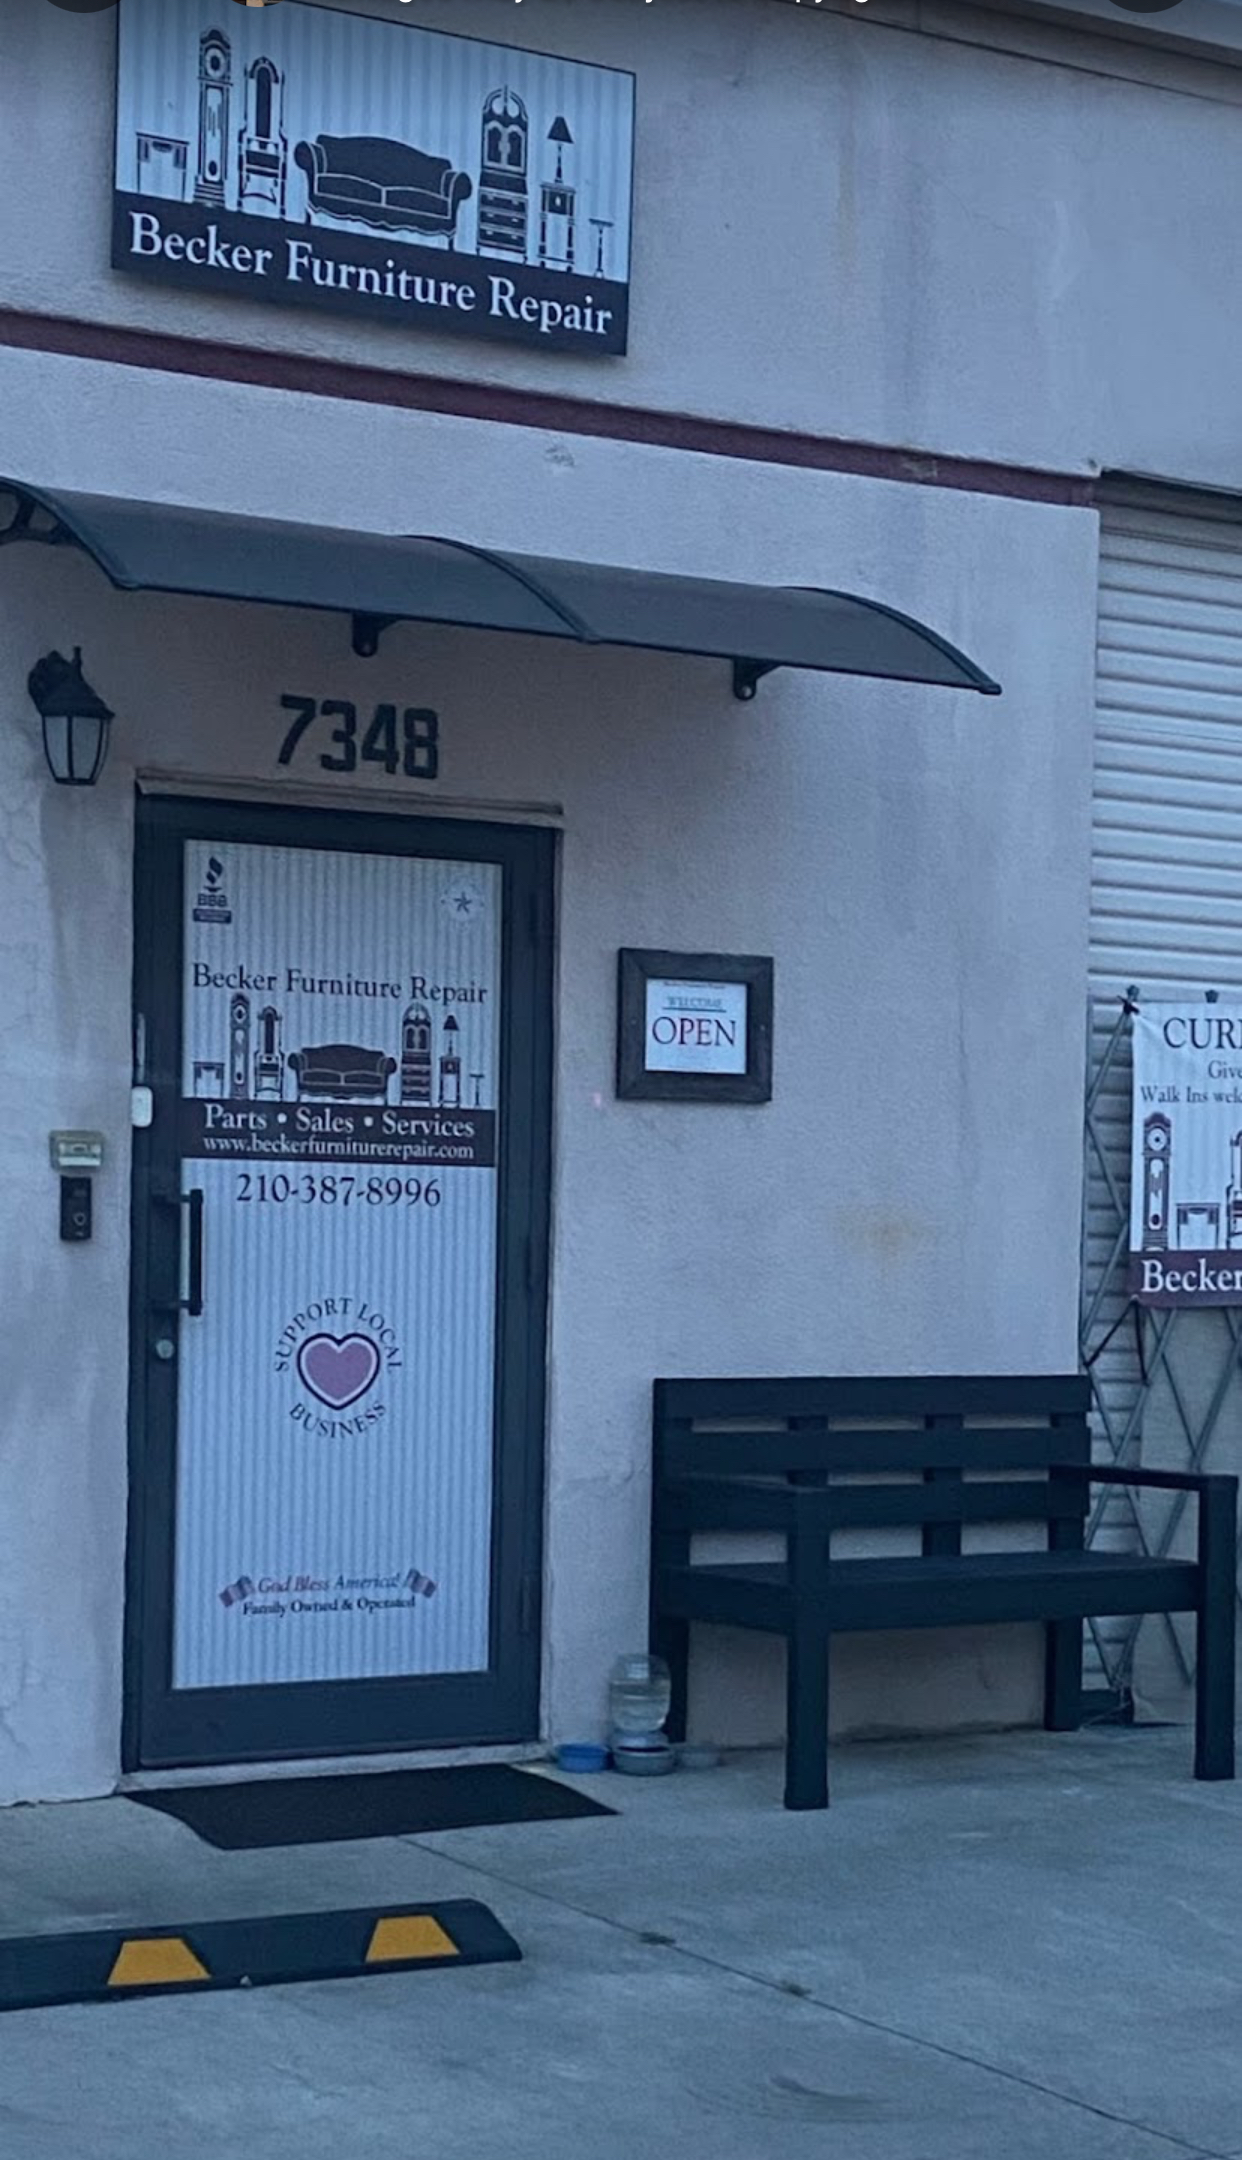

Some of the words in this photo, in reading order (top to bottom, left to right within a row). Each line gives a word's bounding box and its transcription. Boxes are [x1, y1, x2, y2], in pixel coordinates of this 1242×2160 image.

[129, 211, 273, 275] Becker
[286, 239, 477, 311] Furniture
[488, 275, 613, 334] Repair
[278, 693, 439, 779] 7348
[193, 962, 277, 991] Becker
[286, 968, 402, 999] Furniture
[410, 976, 488, 1005] Repair
[652, 1016, 736, 1047] OPEN
[1163, 1017, 1242, 1049] CUR
[1140, 1085, 1180, 1103] Walk
[1186, 1086, 1208, 1103] Ins
[204, 1103, 267, 1129] Parts
[295, 1107, 354, 1134] Sales
[382, 1110, 475, 1137] Services
[203, 1132, 475, 1161] www.beckerfurniturerepair.com
[236, 1173, 441, 1207] 210-387-8996
[1141, 1257, 1242, 1292] Becker
[275, 1297, 353, 1373] SUPPORT
[357, 1303, 402, 1374] LOCAL
[289, 1402, 386, 1439] BUSINESS
[258, 1575, 292, 1593] God
[294, 1575, 330, 1592] Bless
[243, 1601, 287, 1618] Family
[291, 1599, 338, 1613] Owned
[341, 1600, 353, 1611] &
[357, 1595, 415, 1614] Operated
